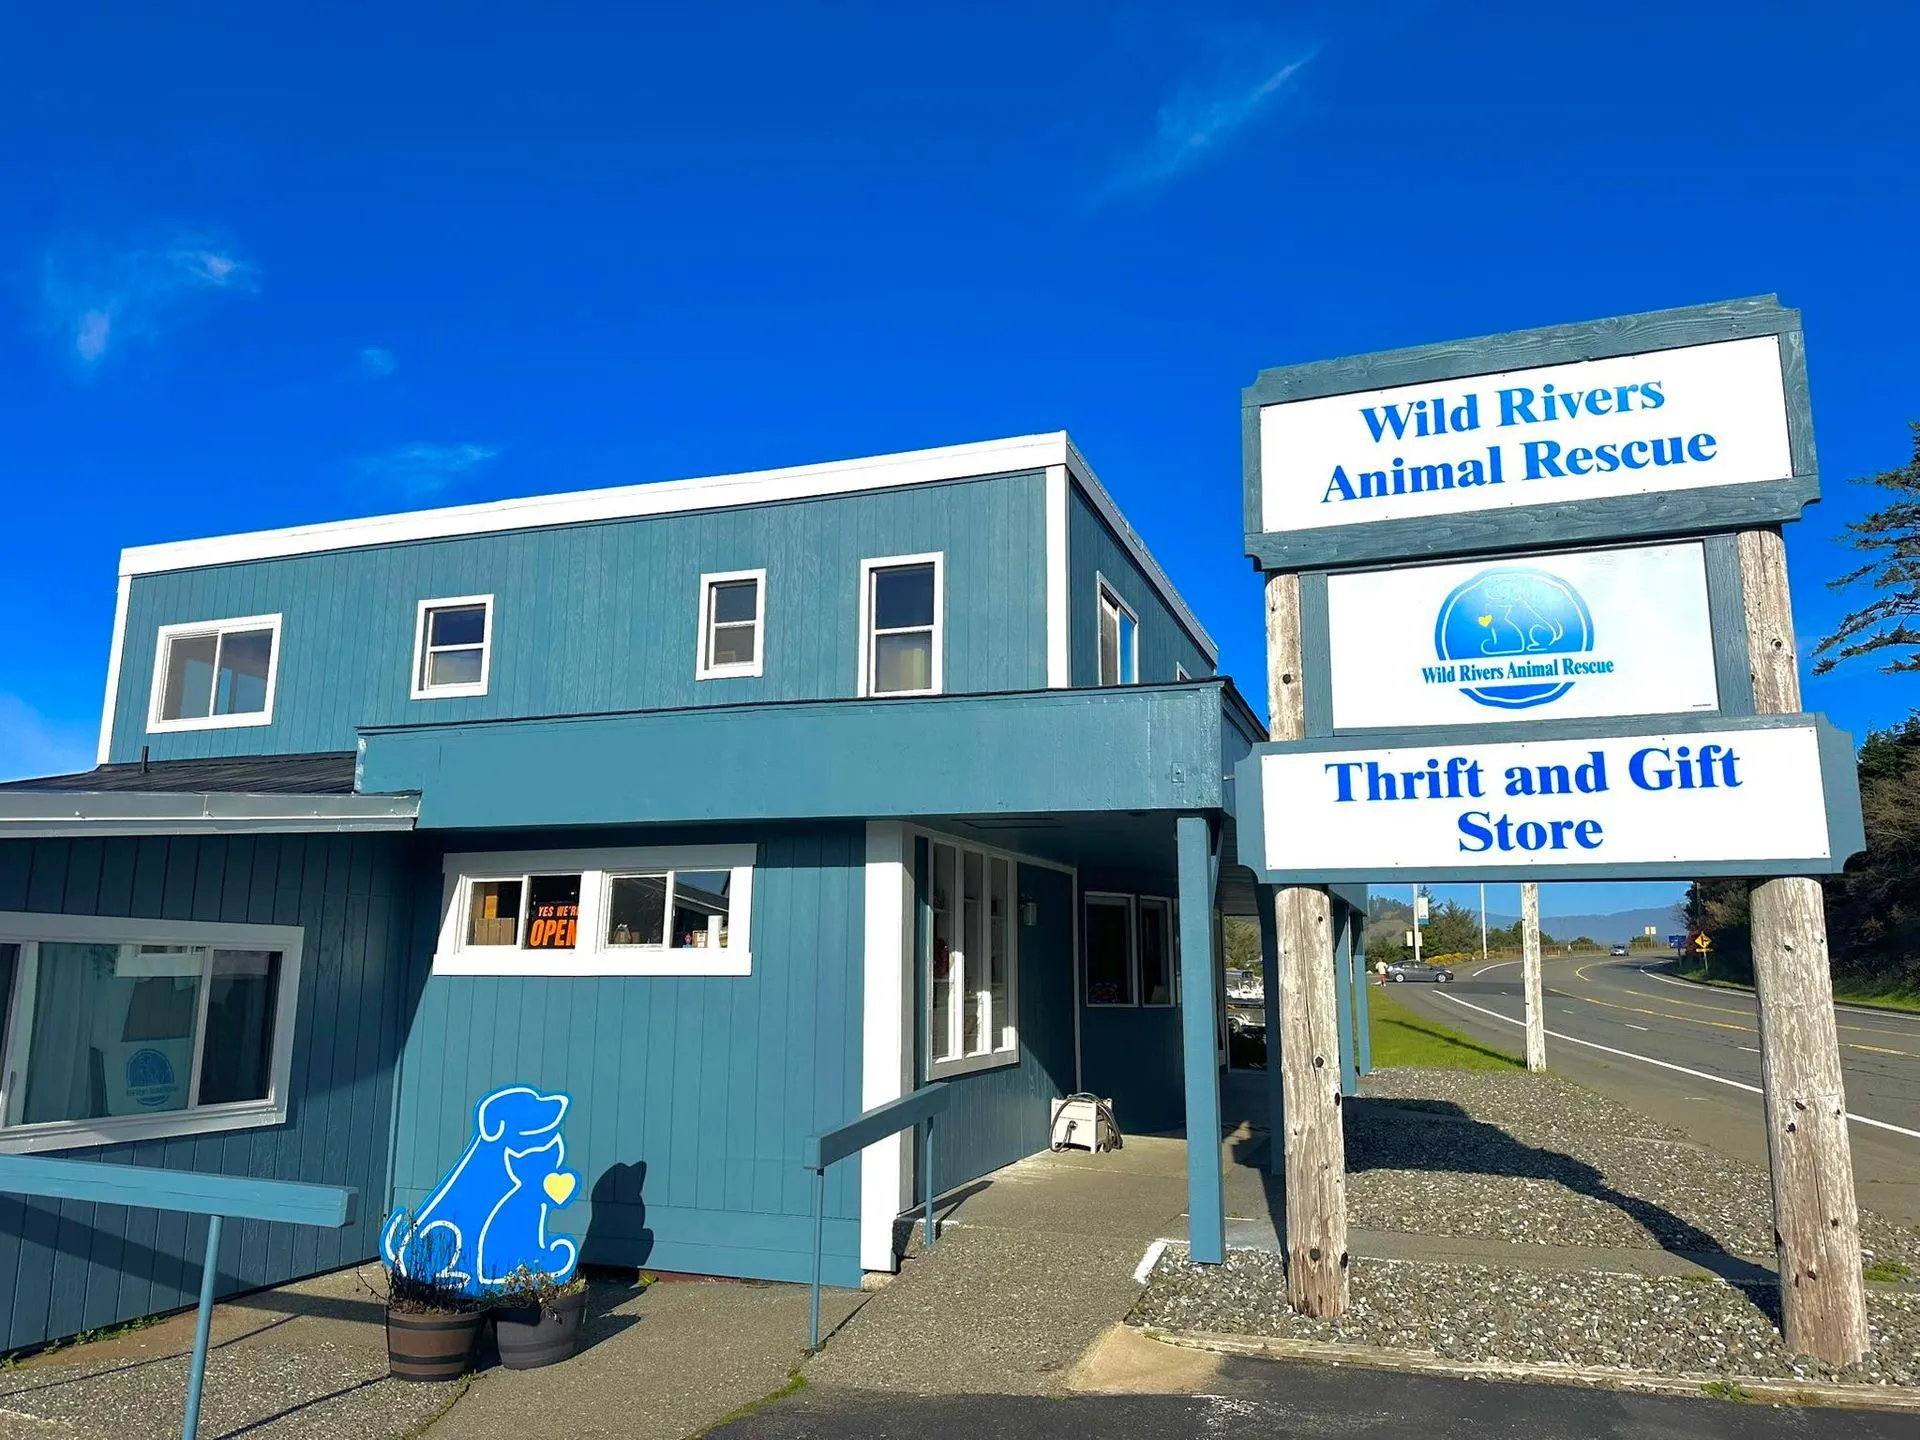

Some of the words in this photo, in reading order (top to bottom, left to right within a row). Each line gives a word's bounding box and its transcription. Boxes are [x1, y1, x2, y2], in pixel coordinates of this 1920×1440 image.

[1359, 394, 1481, 443] Wild
[1496, 381, 1666, 427] Rivers
[1321, 446, 1505, 503] Animal
[1520, 433, 1718, 481] Rescue
[1422, 665, 1456, 684] Wild
[1459, 664, 1505, 682] Rivers
[1507, 659, 1559, 679] Animal
[1562, 658, 1614, 675] Rescue
[1325, 757, 1486, 802] Thrift
[1505, 751, 1610, 796] and
[1629, 745, 1743, 791] Gift
[1458, 811, 1604, 852] Store
[538, 906, 554, 917] YES
[557, 906, 579, 917] WE'R
[530, 919, 577, 946] OPEN
